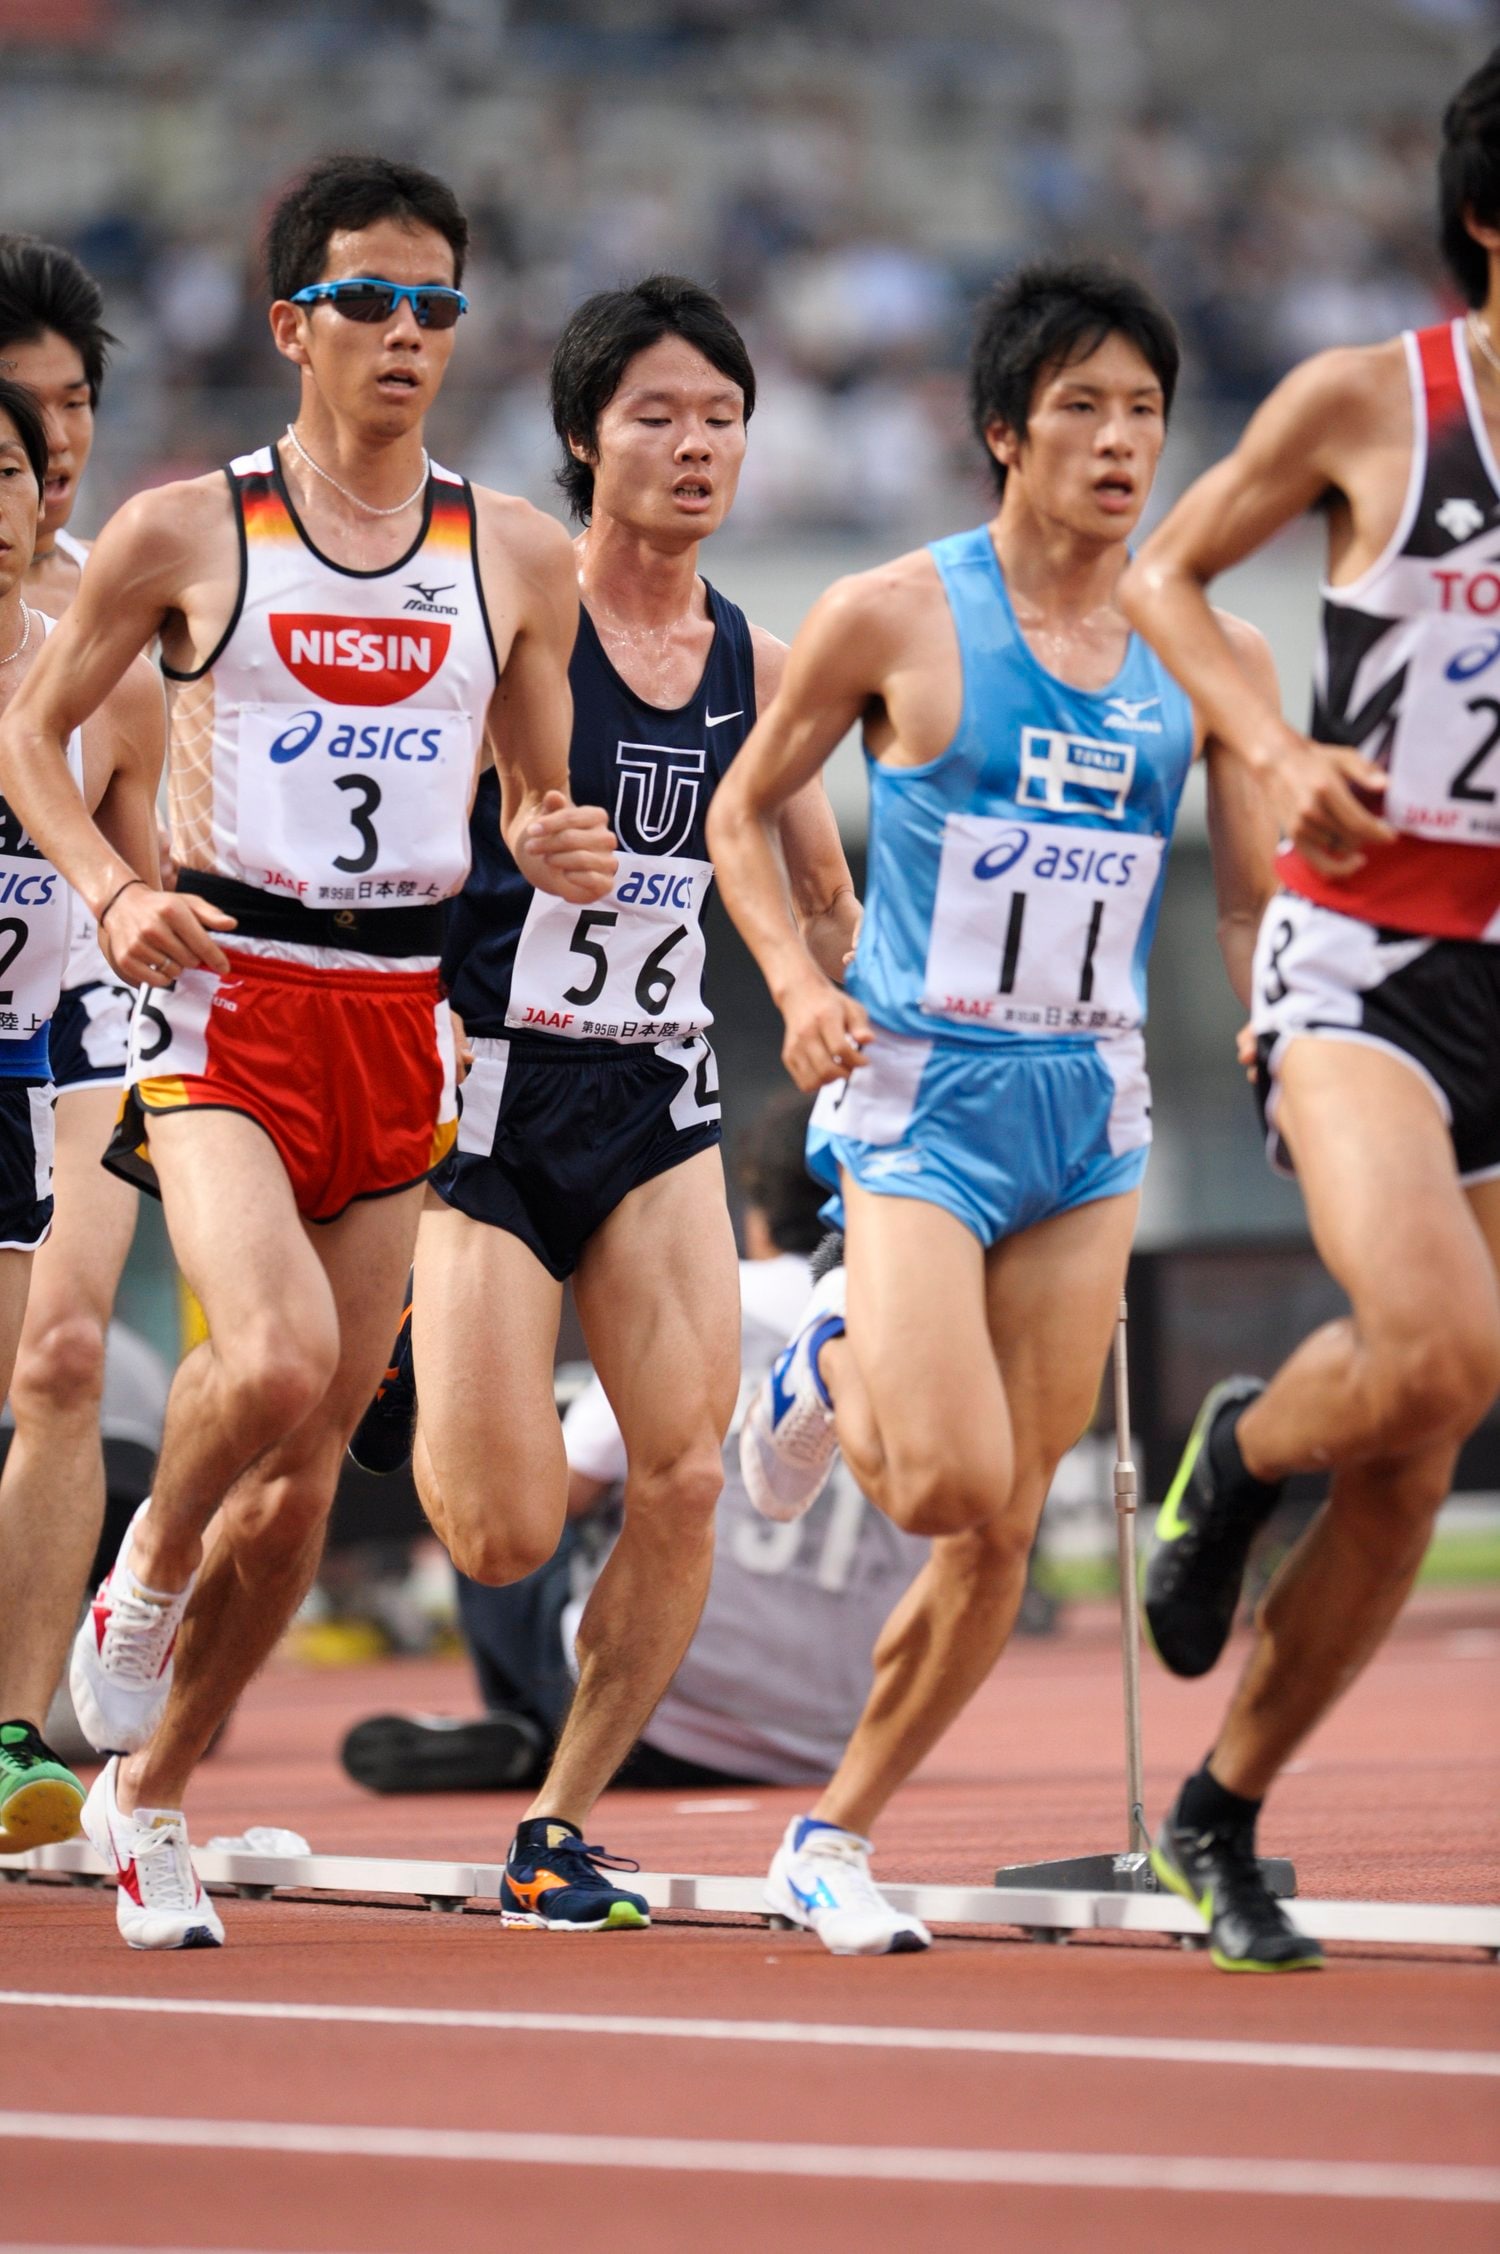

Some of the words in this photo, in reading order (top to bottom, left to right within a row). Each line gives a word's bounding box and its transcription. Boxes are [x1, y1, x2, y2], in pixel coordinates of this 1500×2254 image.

[290, 628, 431, 673] NISSIN
[1448, 696, 1500, 803] 2
[332, 773, 382, 874] 3
[616, 871, 693, 909] asic
[521, 1006, 575, 1029] JAAF
